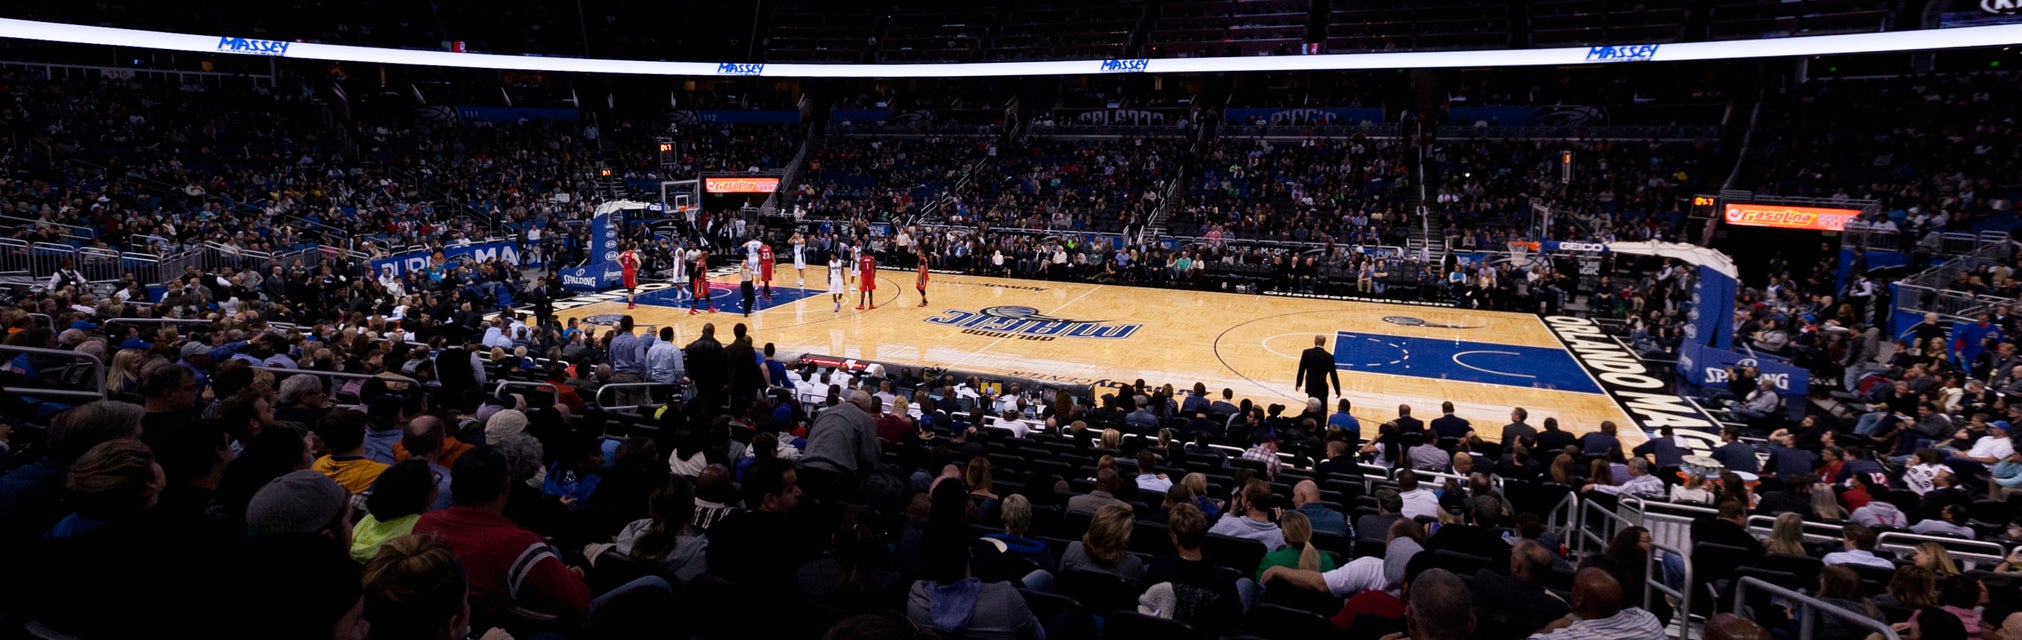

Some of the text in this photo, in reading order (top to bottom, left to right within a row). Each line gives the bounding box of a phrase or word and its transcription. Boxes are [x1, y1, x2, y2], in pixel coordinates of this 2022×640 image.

[218, 36, 290, 56] MASSEY
[1586, 43, 1660, 60] MASSEY
[717, 62, 765, 74] MASSEY
[1100, 58, 1150, 71] MASSEY
[1559, 242, 1603, 251] GEICO
[563, 274, 597, 287] SPALDING
[1544, 315, 1665, 389] ORLANDO
